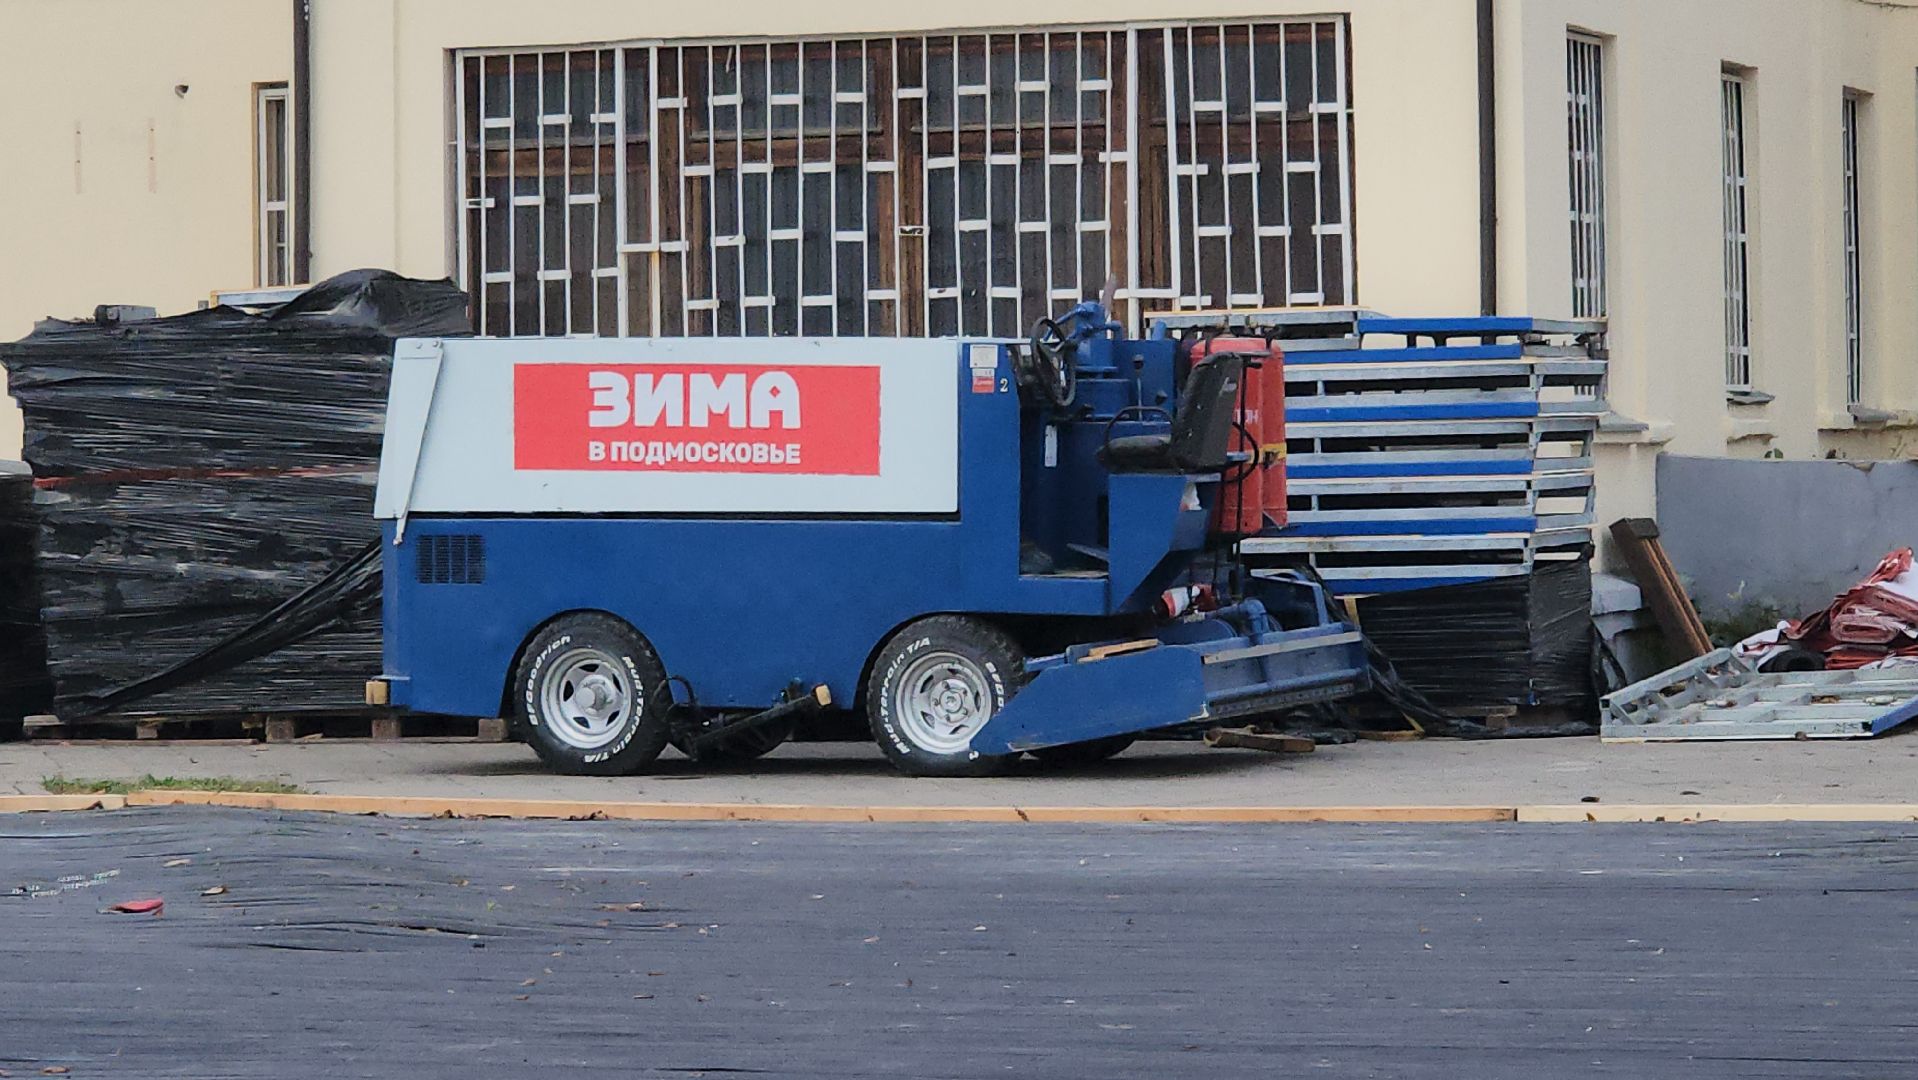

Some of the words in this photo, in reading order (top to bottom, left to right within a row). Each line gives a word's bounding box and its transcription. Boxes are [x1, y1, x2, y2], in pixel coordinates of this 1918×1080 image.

[1000, 378, 1009, 393] 2
[588, 371, 801, 429] ЗИМА
[588, 441, 606, 462] В
[610, 441, 801, 465] ПОДМОСКОВЬЕ
